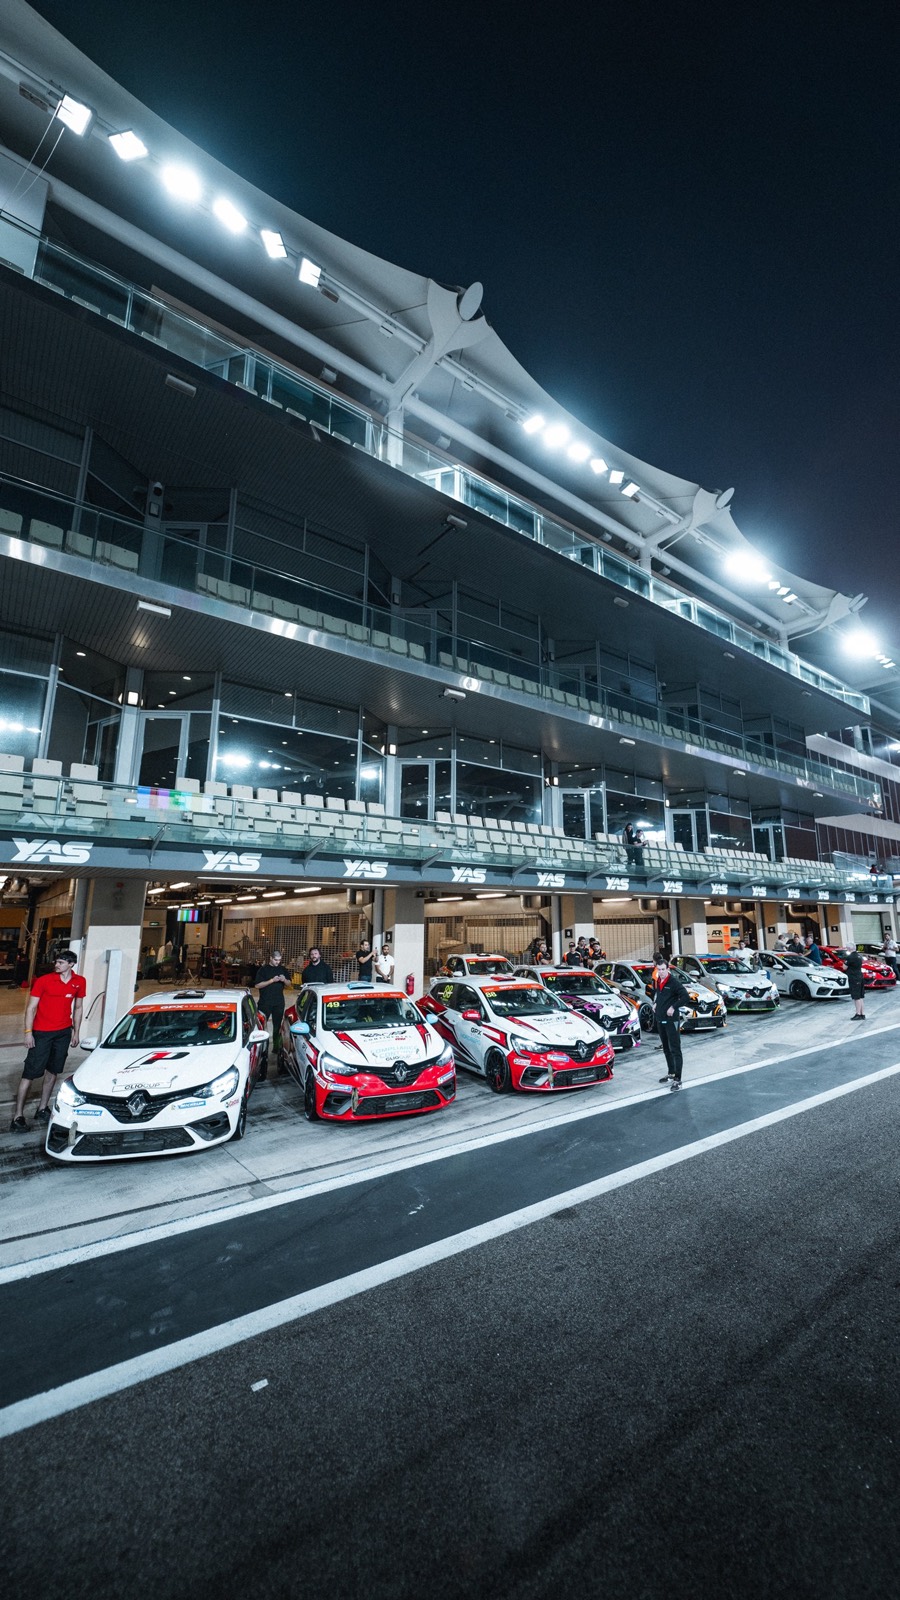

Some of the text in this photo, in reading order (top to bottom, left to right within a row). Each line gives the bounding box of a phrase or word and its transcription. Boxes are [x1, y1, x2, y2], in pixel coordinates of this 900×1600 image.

[11, 837, 94, 864] YAS
[202, 849, 262, 872] YAS
[343, 859, 388, 879] YAS
[451, 866, 487, 883] YAS
[536, 872, 566, 888] YAS
[605, 876, 630, 891] YAS
[662, 880, 683, 894] YAS
[711, 883, 729, 895] YAS
[752, 886, 767, 897] YAS
[788, 889, 801, 899] YAS
[818, 891, 830, 901] YAS
[327, 1001, 340, 1009] 49
[470, 1026, 482, 1036] GPX
